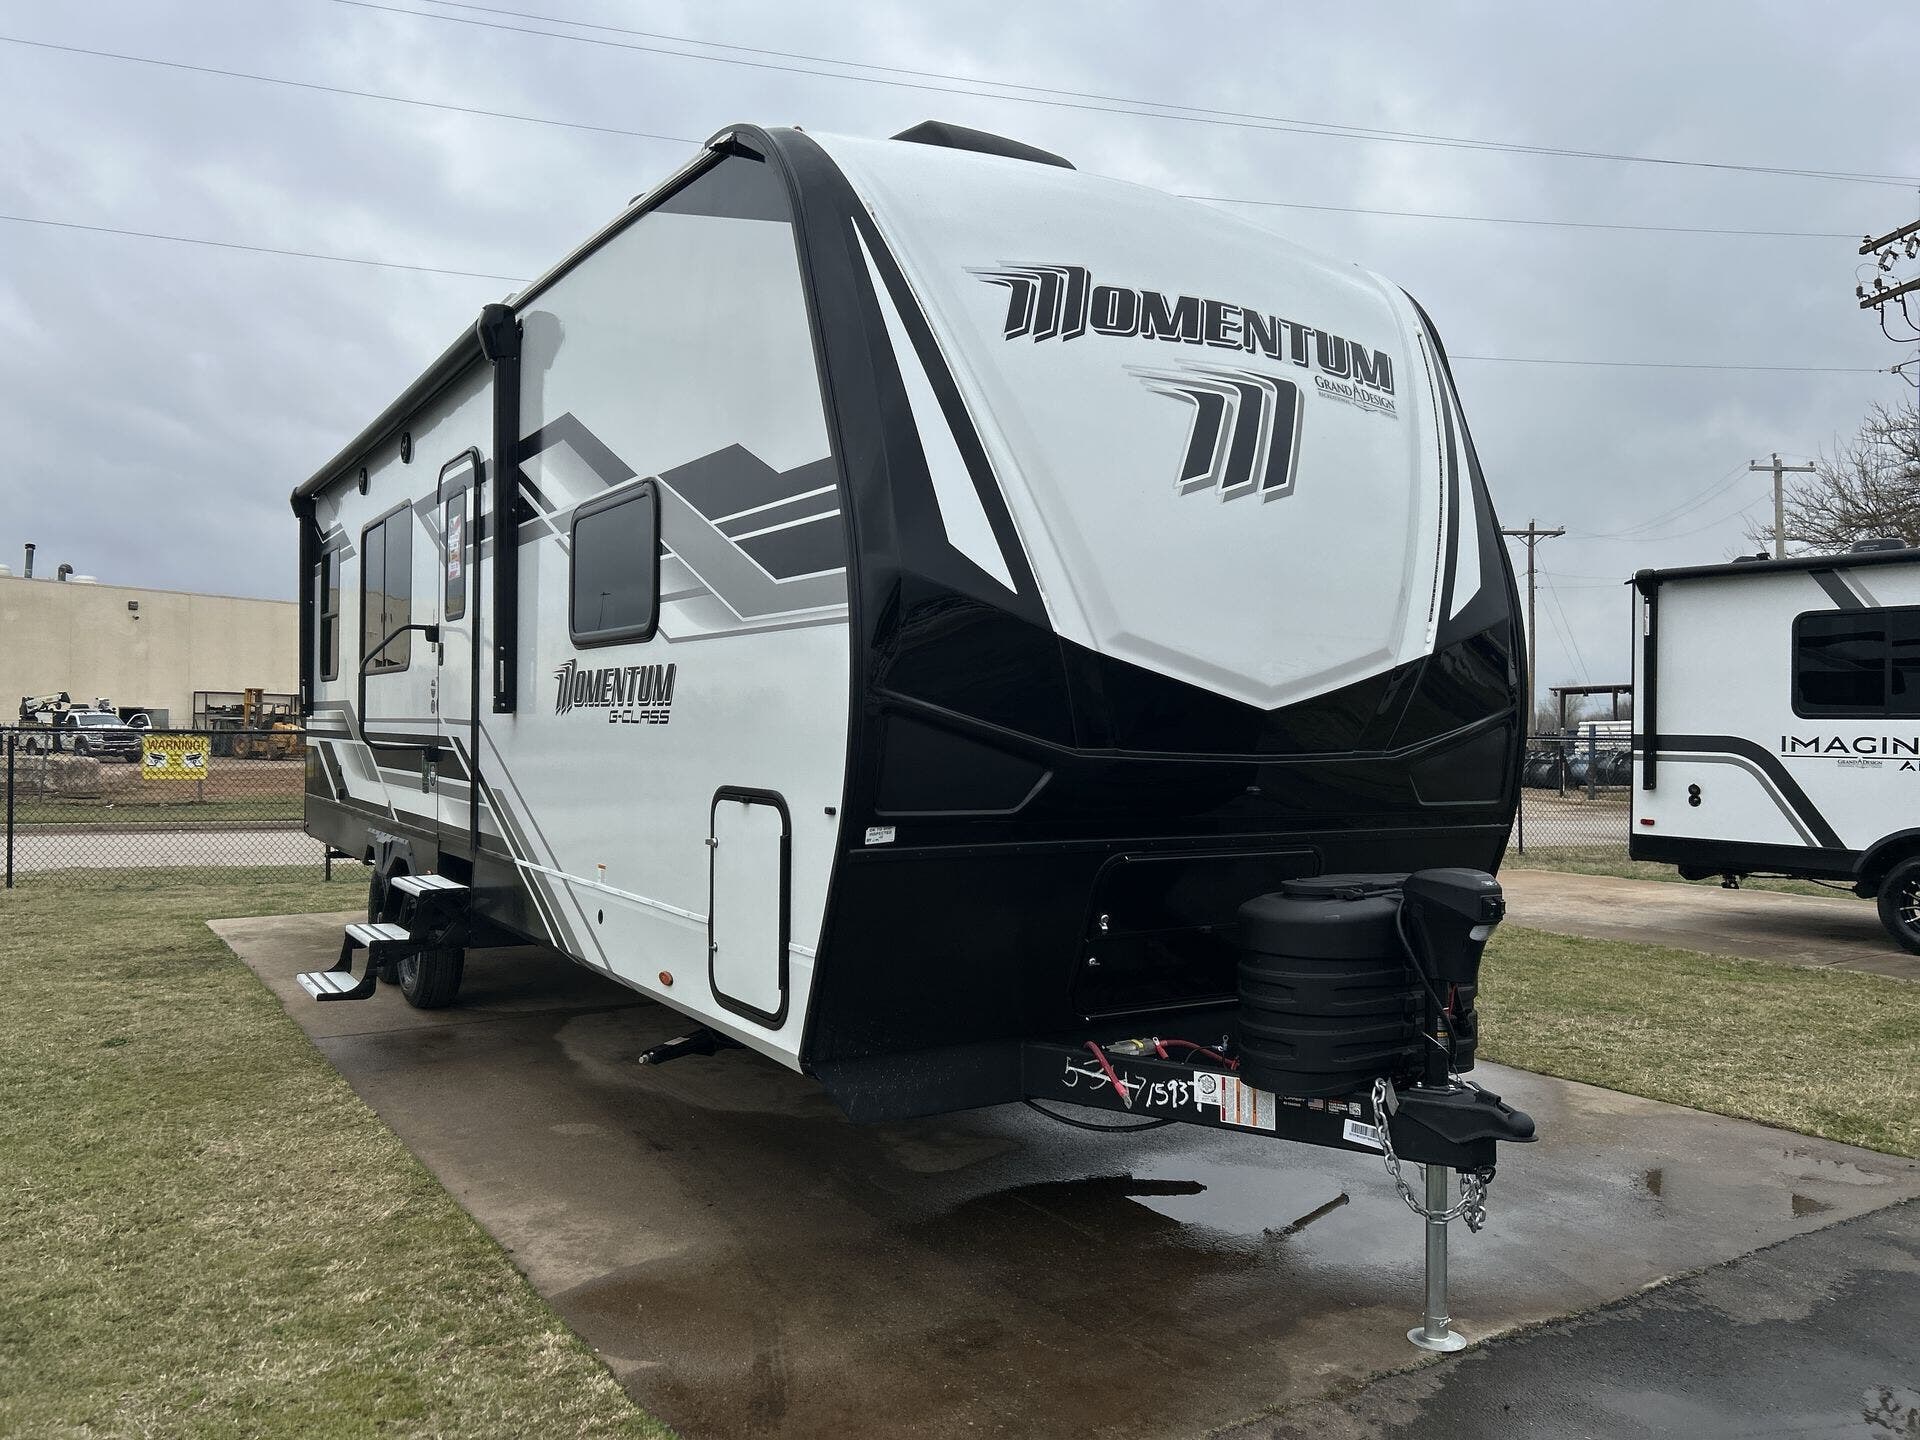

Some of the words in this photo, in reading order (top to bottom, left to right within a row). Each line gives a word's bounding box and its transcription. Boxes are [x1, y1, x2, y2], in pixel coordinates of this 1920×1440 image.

[963, 261, 1395, 396] MOMENTUM
[1314, 375, 1353, 397] GRAND
[1361, 389, 1396, 410] DESIGN
[553, 658, 677, 716] MOMENTUM
[608, 709, 670, 725] G-CLASS
[147, 739, 204, 751] WARNING!
[1781, 735, 1919, 755] IMAGIN
[1898, 760, 1920, 772] A
